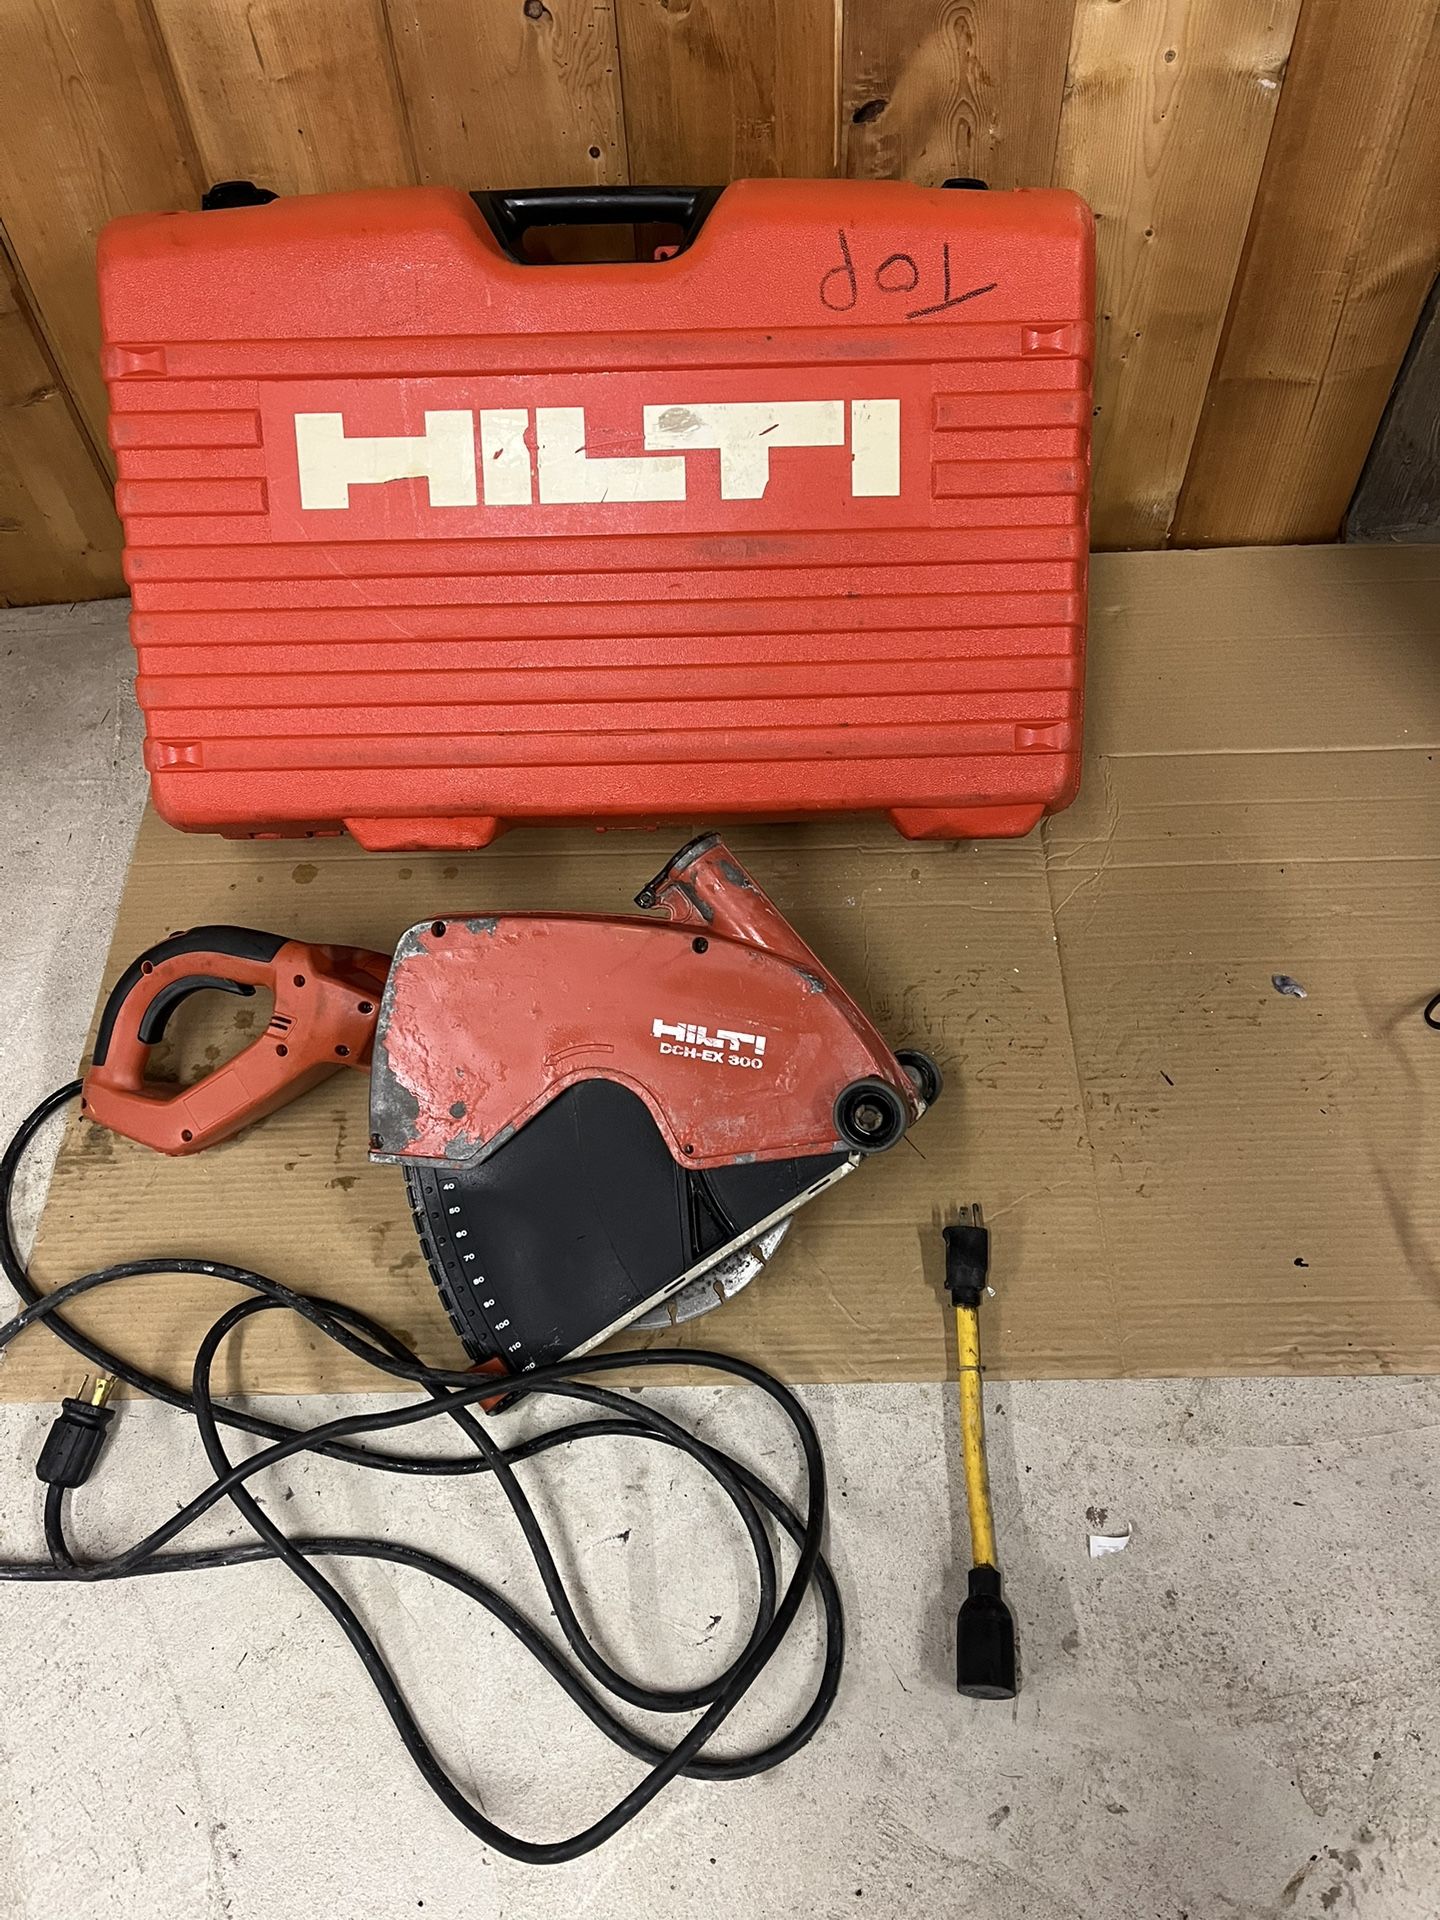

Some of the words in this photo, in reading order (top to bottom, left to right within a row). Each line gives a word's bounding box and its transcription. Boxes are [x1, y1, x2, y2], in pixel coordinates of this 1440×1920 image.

[294, 399, 901, 510] HILTI
[652, 1018, 766, 1055] HILTI
[660, 1042, 724, 1064] DCH-EX
[728, 1054, 763, 1069] 300
[443, 1182, 455, 1190] 40
[463, 1252, 475, 1262] 70
[494, 1319, 510, 1331] 100
[508, 1341, 522, 1353] 110
